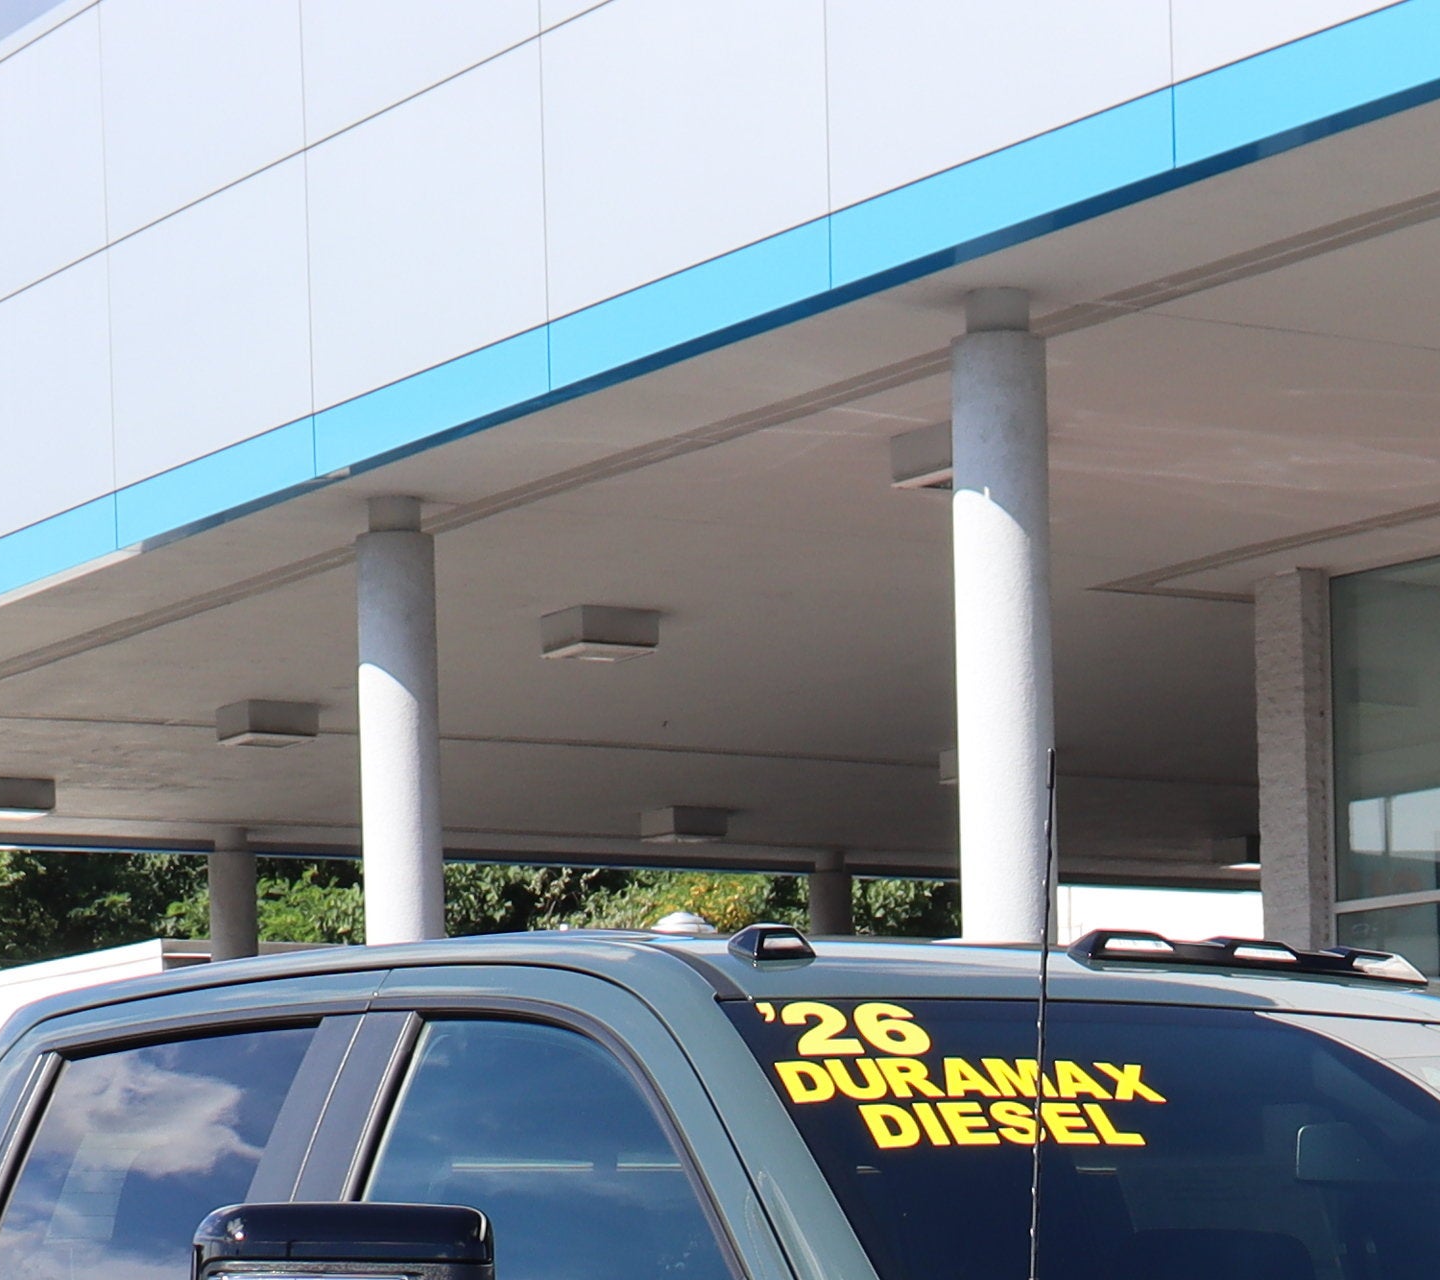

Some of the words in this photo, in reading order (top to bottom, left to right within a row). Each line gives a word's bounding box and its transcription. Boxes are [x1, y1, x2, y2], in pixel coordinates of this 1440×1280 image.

[755, 1001, 932, 1056] '26
[774, 1056, 1167, 1104] DURAMAX
[858, 1100, 1147, 1149] DIESEL
